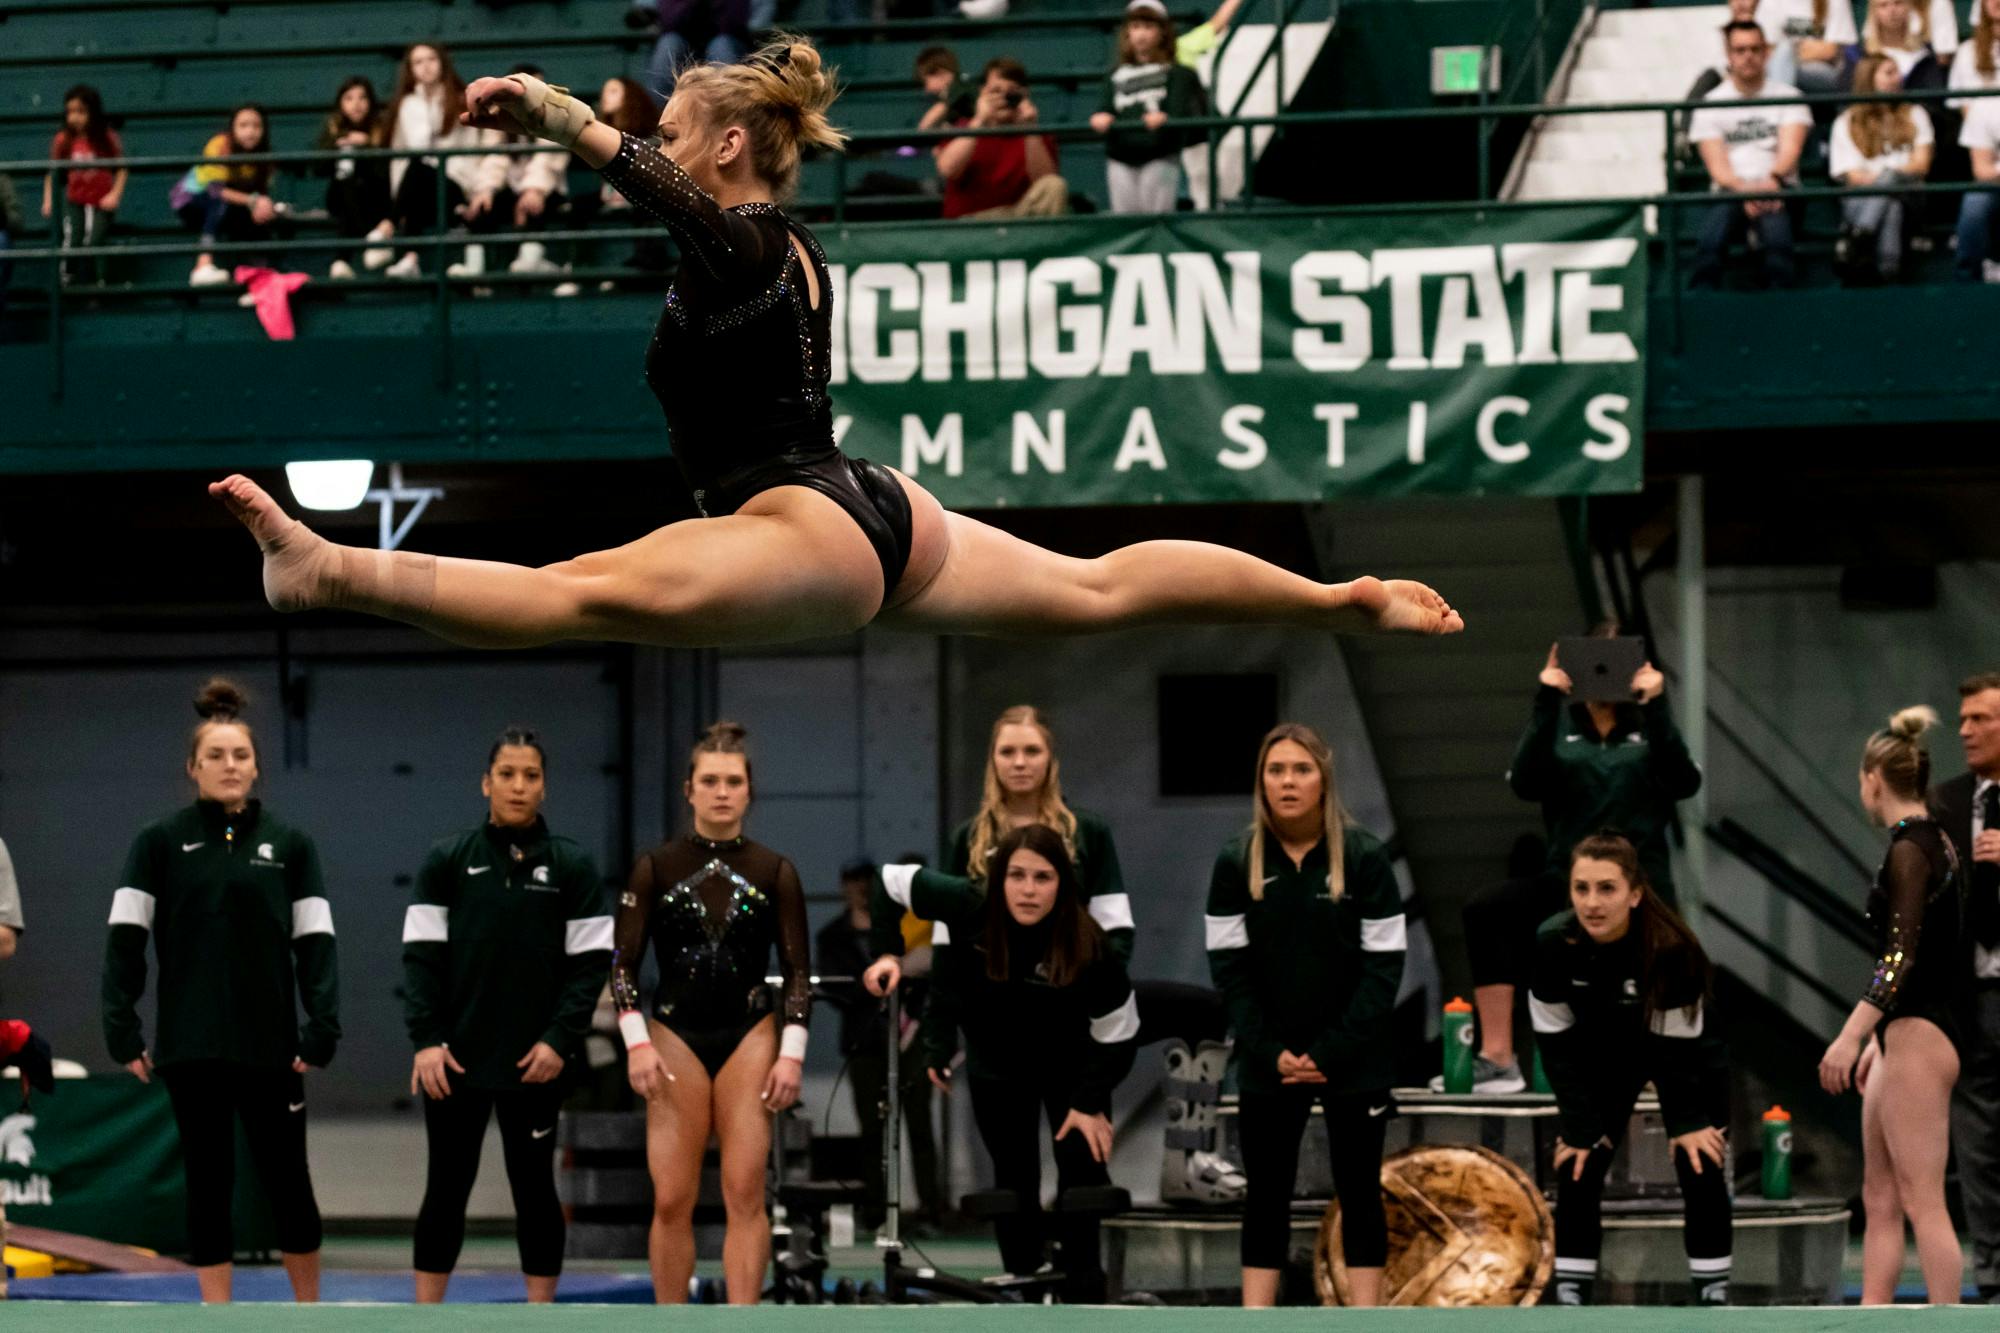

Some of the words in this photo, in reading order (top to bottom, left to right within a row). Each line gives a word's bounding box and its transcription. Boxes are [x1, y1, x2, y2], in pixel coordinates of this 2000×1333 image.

[830, 251, 1262, 384] ICHIGAN
[1291, 238, 1639, 373] STATE
[834, 394, 1631, 477] MNASTICS
[2, 1173, 53, 1206] ault
